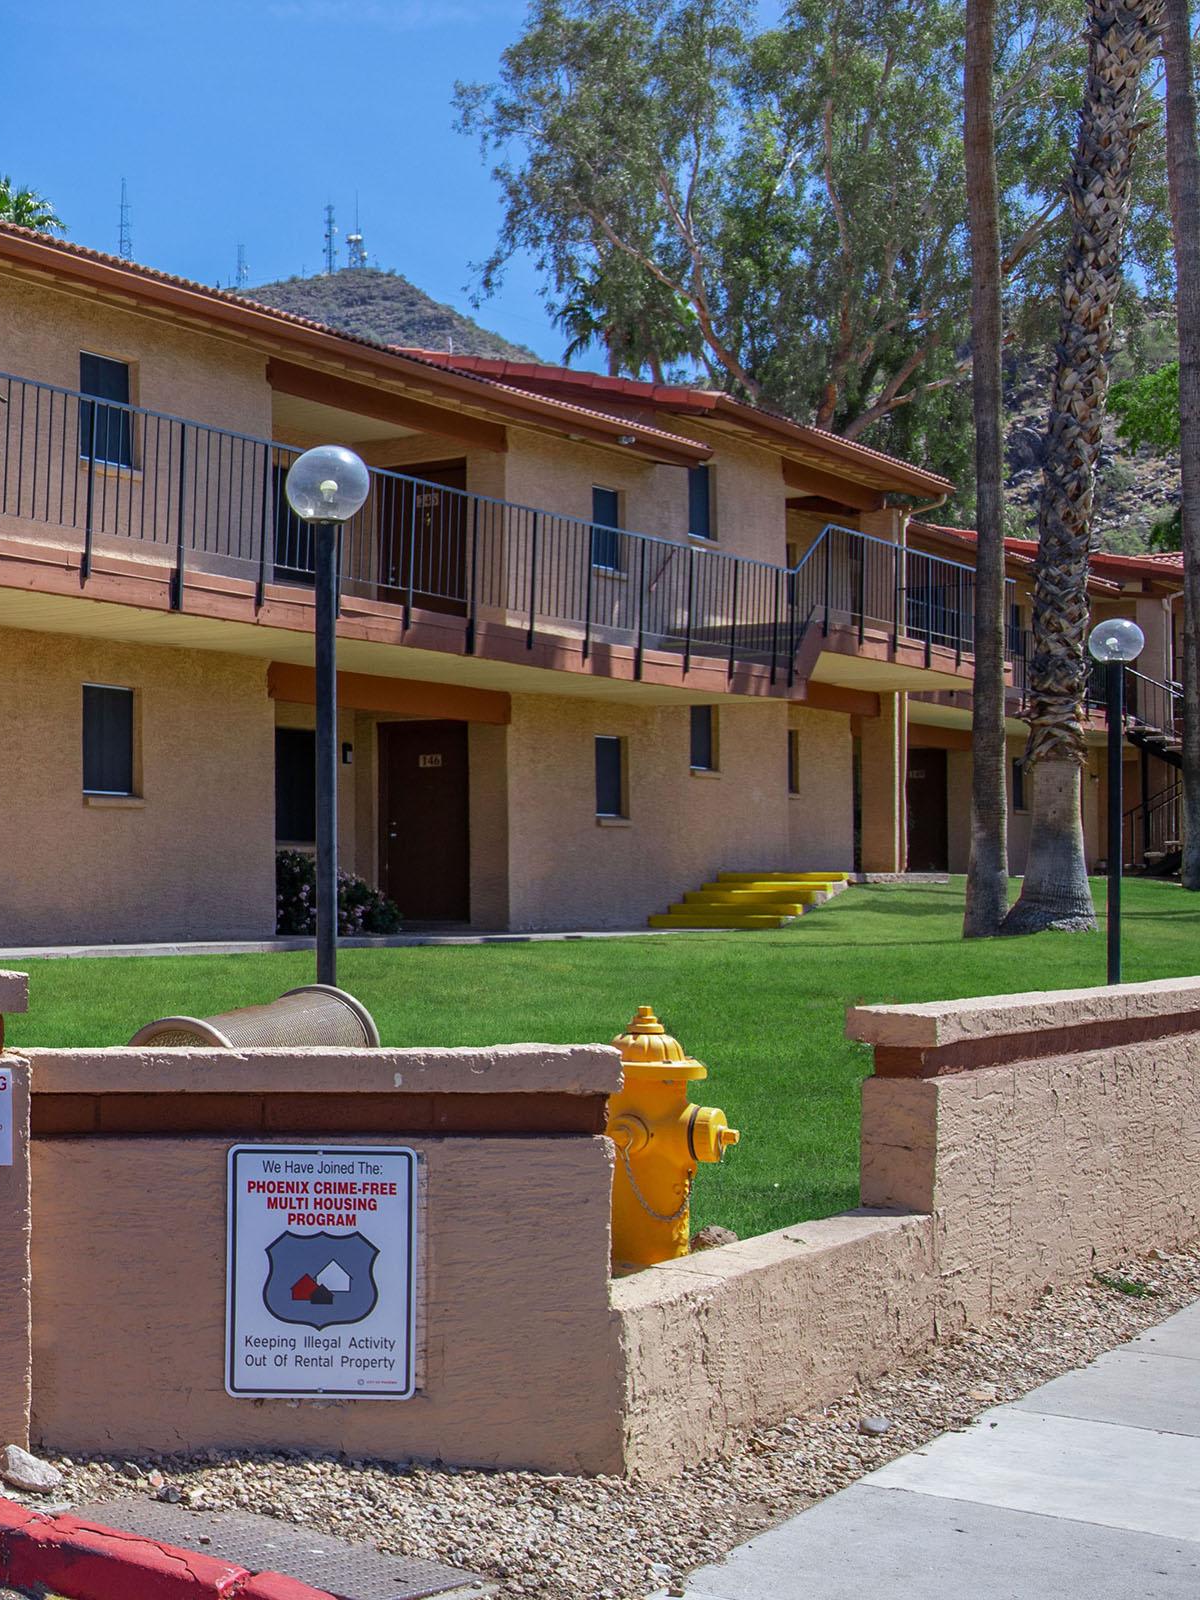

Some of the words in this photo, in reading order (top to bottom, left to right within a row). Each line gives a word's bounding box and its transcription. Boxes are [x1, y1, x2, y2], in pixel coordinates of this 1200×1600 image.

[263, 1160, 281, 1173] We
[285, 1161, 314, 1174] Have
[317, 1161, 355, 1175] Joined
[358, 1162, 383, 1175] The:
[248, 1181, 309, 1194] PHOENIX
[314, 1182, 397, 1195] CRIME-FREE
[267, 1197, 308, 1210] MULTI
[314, 1198, 377, 1211] HOUSING
[288, 1214, 356, 1226] PROGRAM
[245, 1336, 296, 1351] Keeping
[304, 1337, 341, 1351] Illegal
[349, 1337, 396, 1352] Activity
[245, 1355, 267, 1367] Out
[274, 1355, 288, 1367] Of
[295, 1355, 333, 1368] Rental
[341, 1356, 395, 1371] Property
